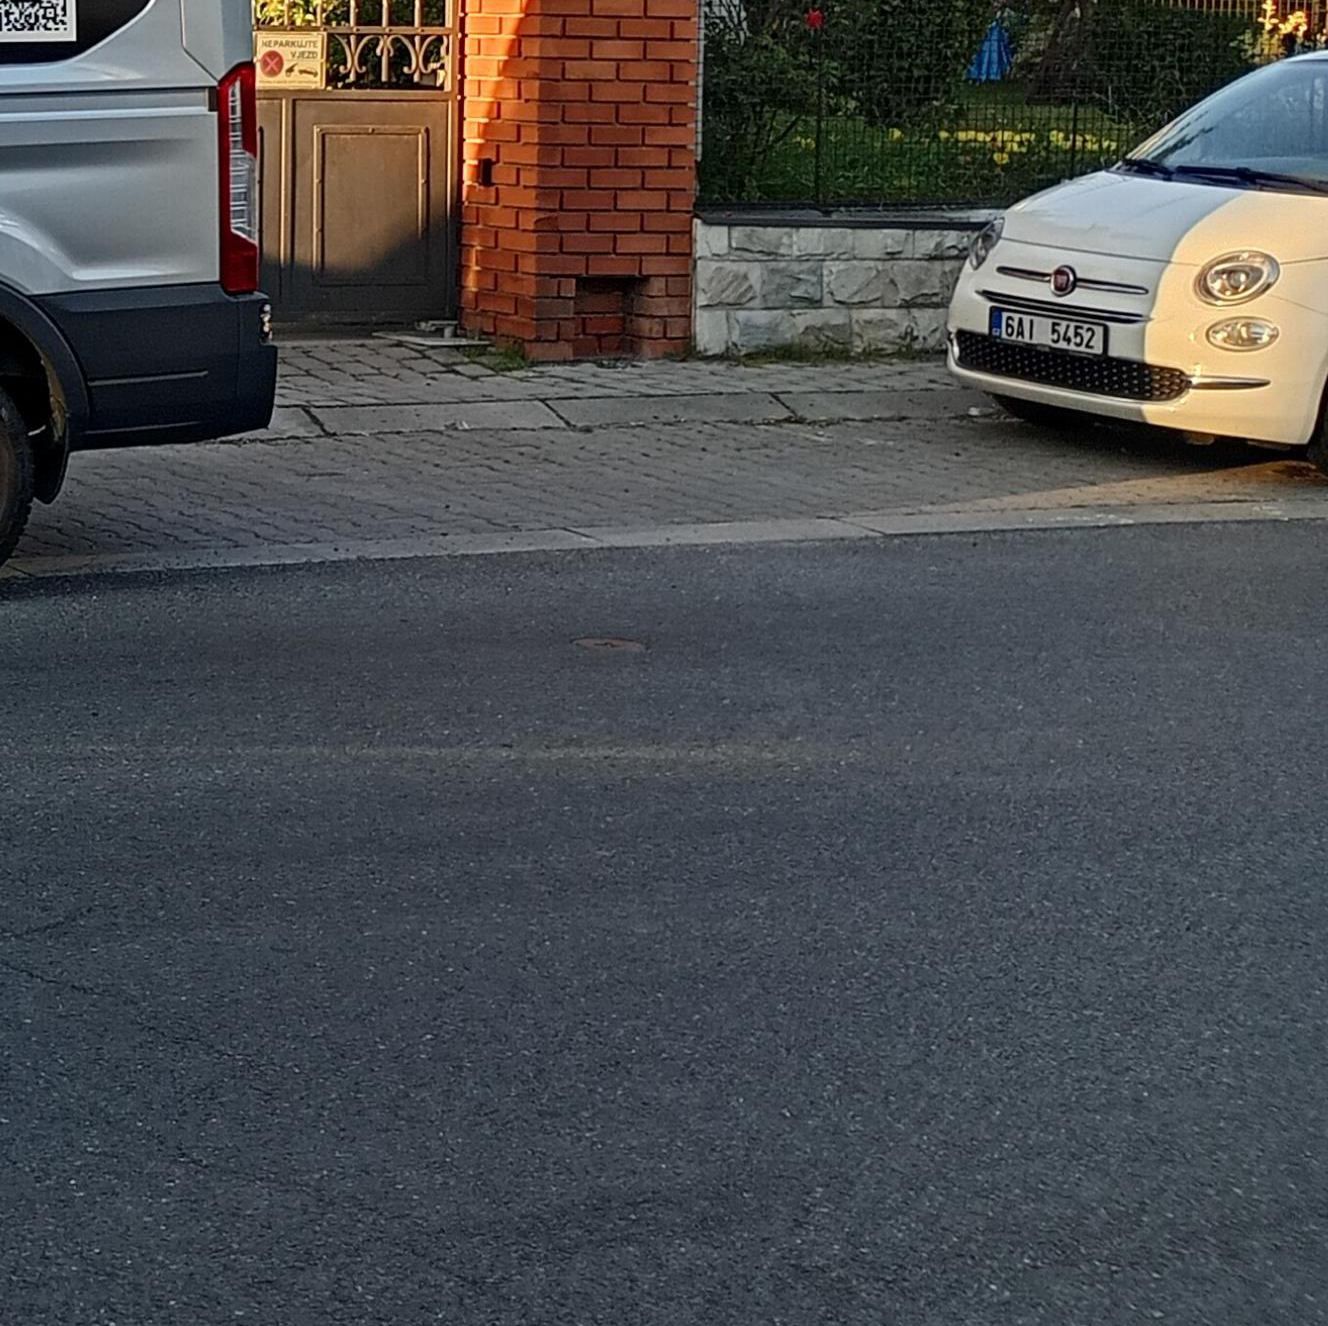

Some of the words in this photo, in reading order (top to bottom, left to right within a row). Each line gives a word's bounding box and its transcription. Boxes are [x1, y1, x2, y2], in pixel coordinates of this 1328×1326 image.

[261, 39, 319, 48] NEPARKUJTE
[290, 50, 318, 59] VJEZD
[1051, 322, 1096, 349] 5452
